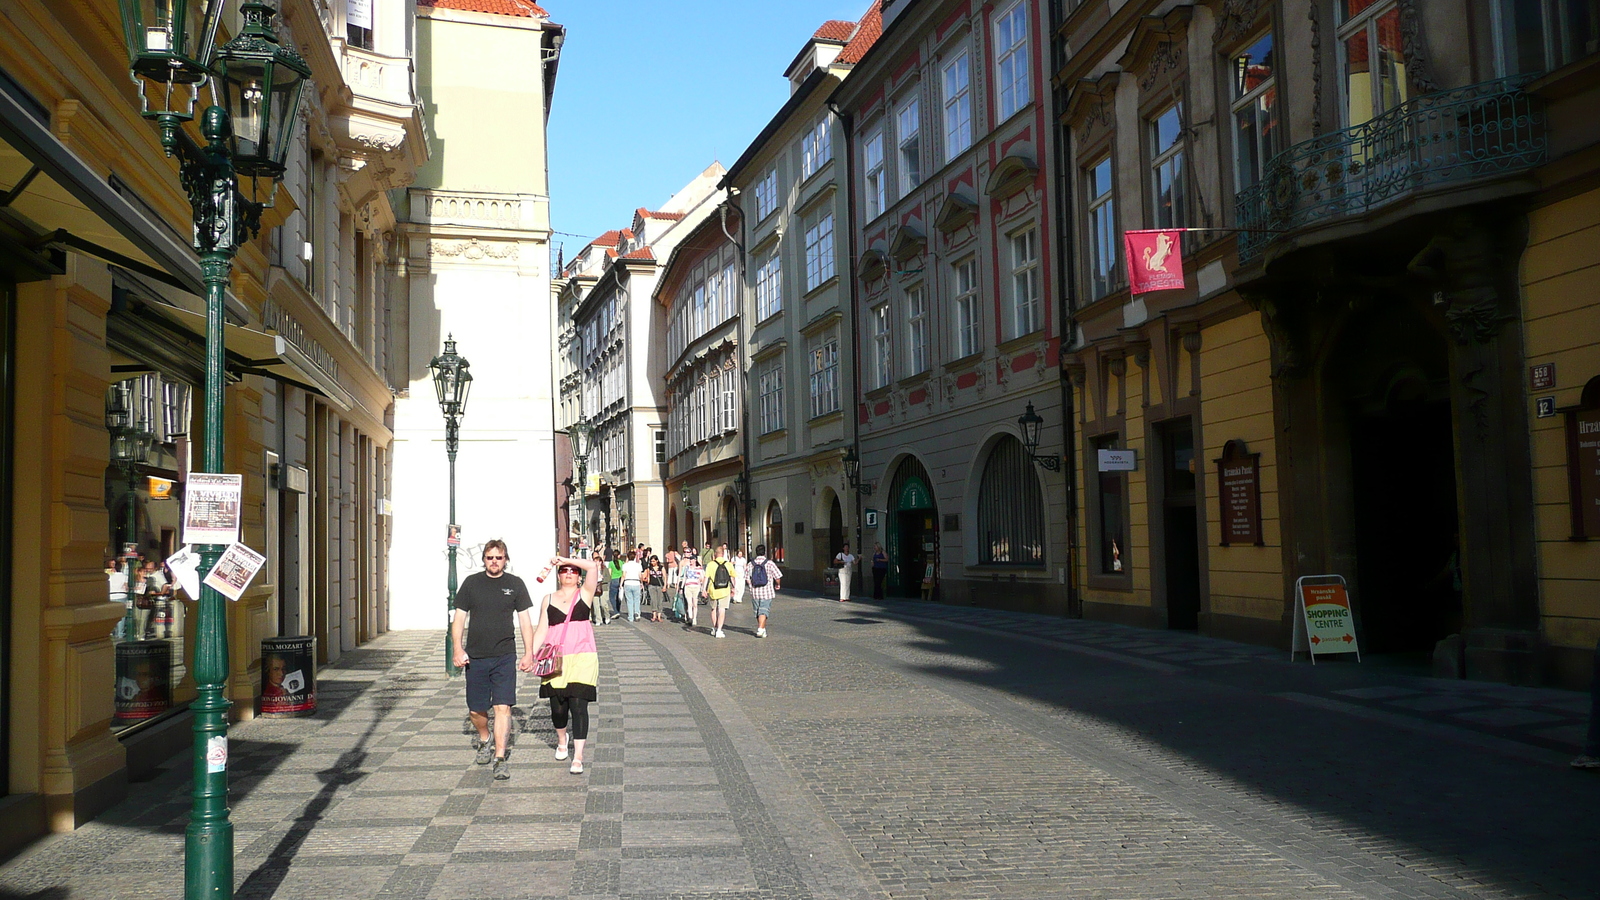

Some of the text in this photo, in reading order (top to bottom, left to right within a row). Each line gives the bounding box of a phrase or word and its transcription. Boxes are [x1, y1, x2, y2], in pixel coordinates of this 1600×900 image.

[1534, 367, 1548, 378] 558
[1539, 402, 1549, 413] 12
[1307, 609, 1348, 618] SHOPPING
[1315, 620, 1344, 628] CENTRE
[271, 694, 304, 702] GIOVANNI
